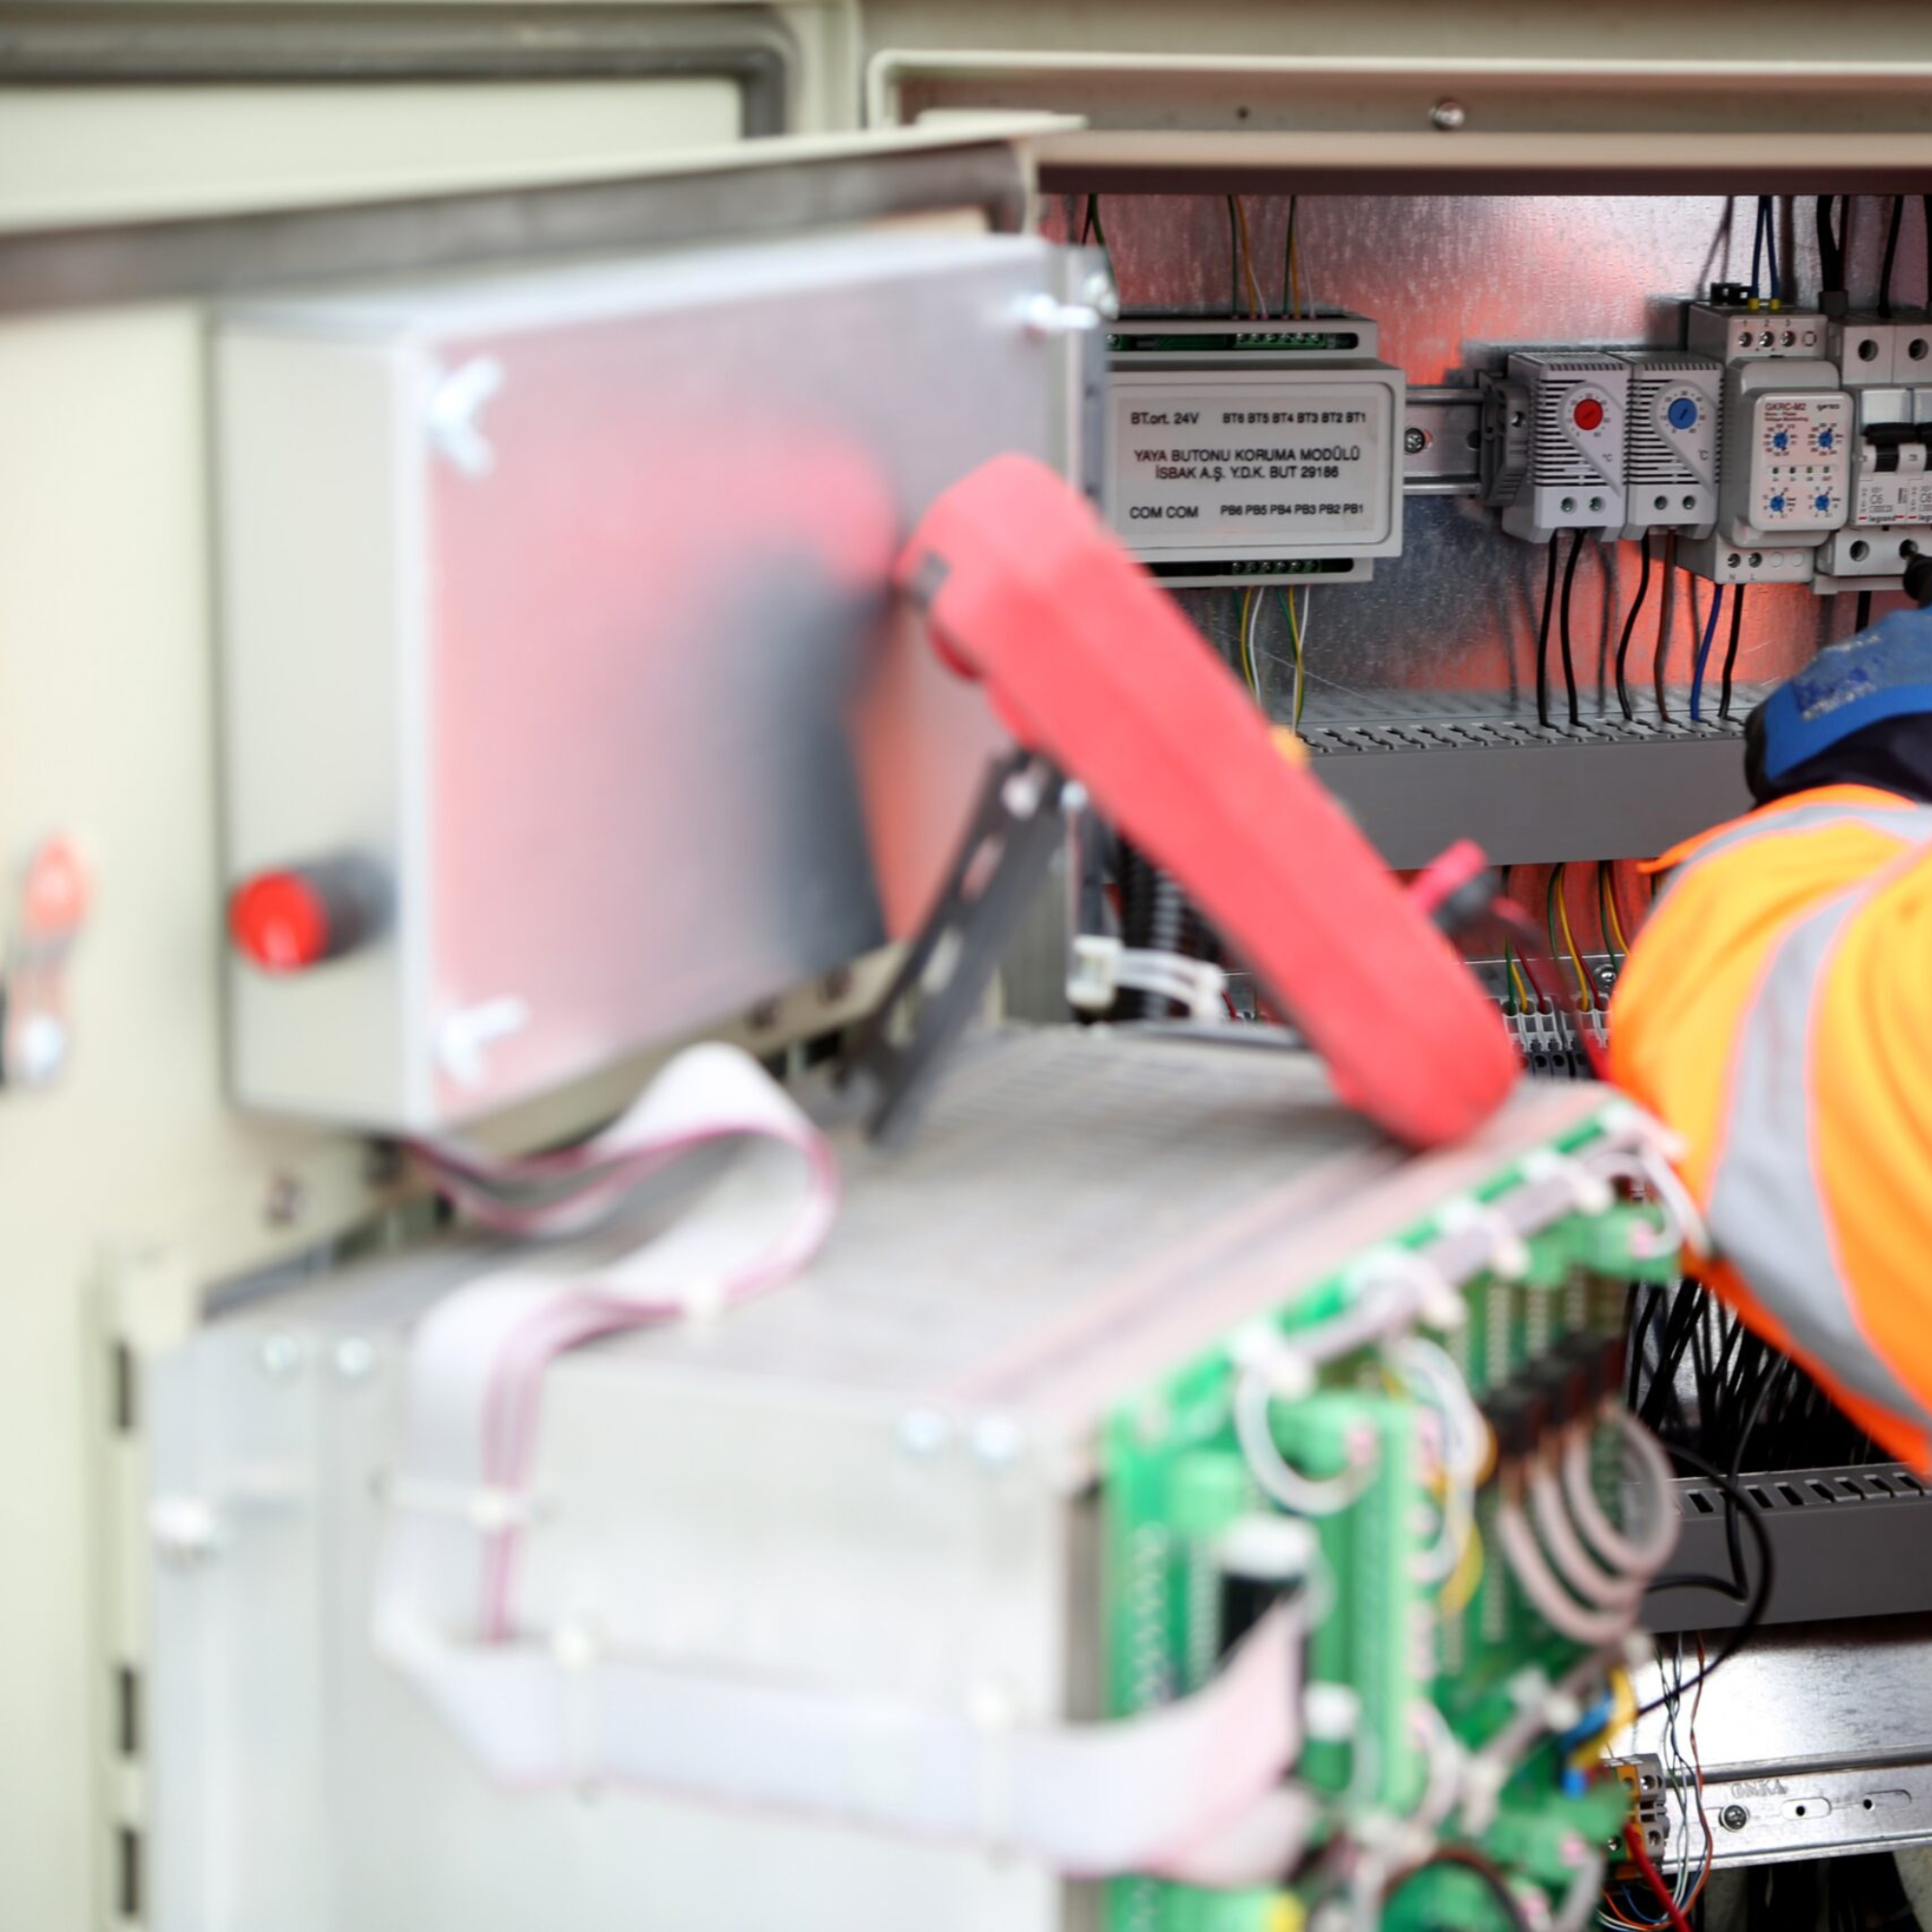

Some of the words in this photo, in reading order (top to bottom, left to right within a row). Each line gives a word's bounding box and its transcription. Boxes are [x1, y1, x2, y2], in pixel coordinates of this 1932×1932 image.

[1174, 412, 1200, 424] 24V
[1222, 412, 1245, 424] BT6
[1247, 412, 1269, 424] BT5
[1272, 412, 1294, 424] BT4
[1296, 412, 1319, 424] BT3
[1321, 412, 1344, 424] BT2
[1346, 411, 1367, 423] BT1
[1134, 448, 1167, 463] YAYA
[1171, 447, 1231, 462] BUTONU
[1235, 447, 1296, 462] KORUMA
[1299, 444, 1361, 462] MODÜLÜ
[1155, 464, 1197, 479] İSBAK
[1199, 466, 1226, 482] A.Ş.
[1230, 466, 1266, 479] Y.D.K.
[1269, 466, 1297, 479] BUT
[1300, 466, 1340, 479] 29186
[1129, 506, 1162, 520] COM
[1165, 505, 1200, 519] COM
[1220, 504, 1243, 517] PB6
[1245, 503, 1267, 516] PB5
[1269, 503, 1293, 516] PB4
[1294, 503, 1317, 515] PB3
[1319, 502, 1341, 515] PB2
[1343, 502, 1364, 515] PB1
